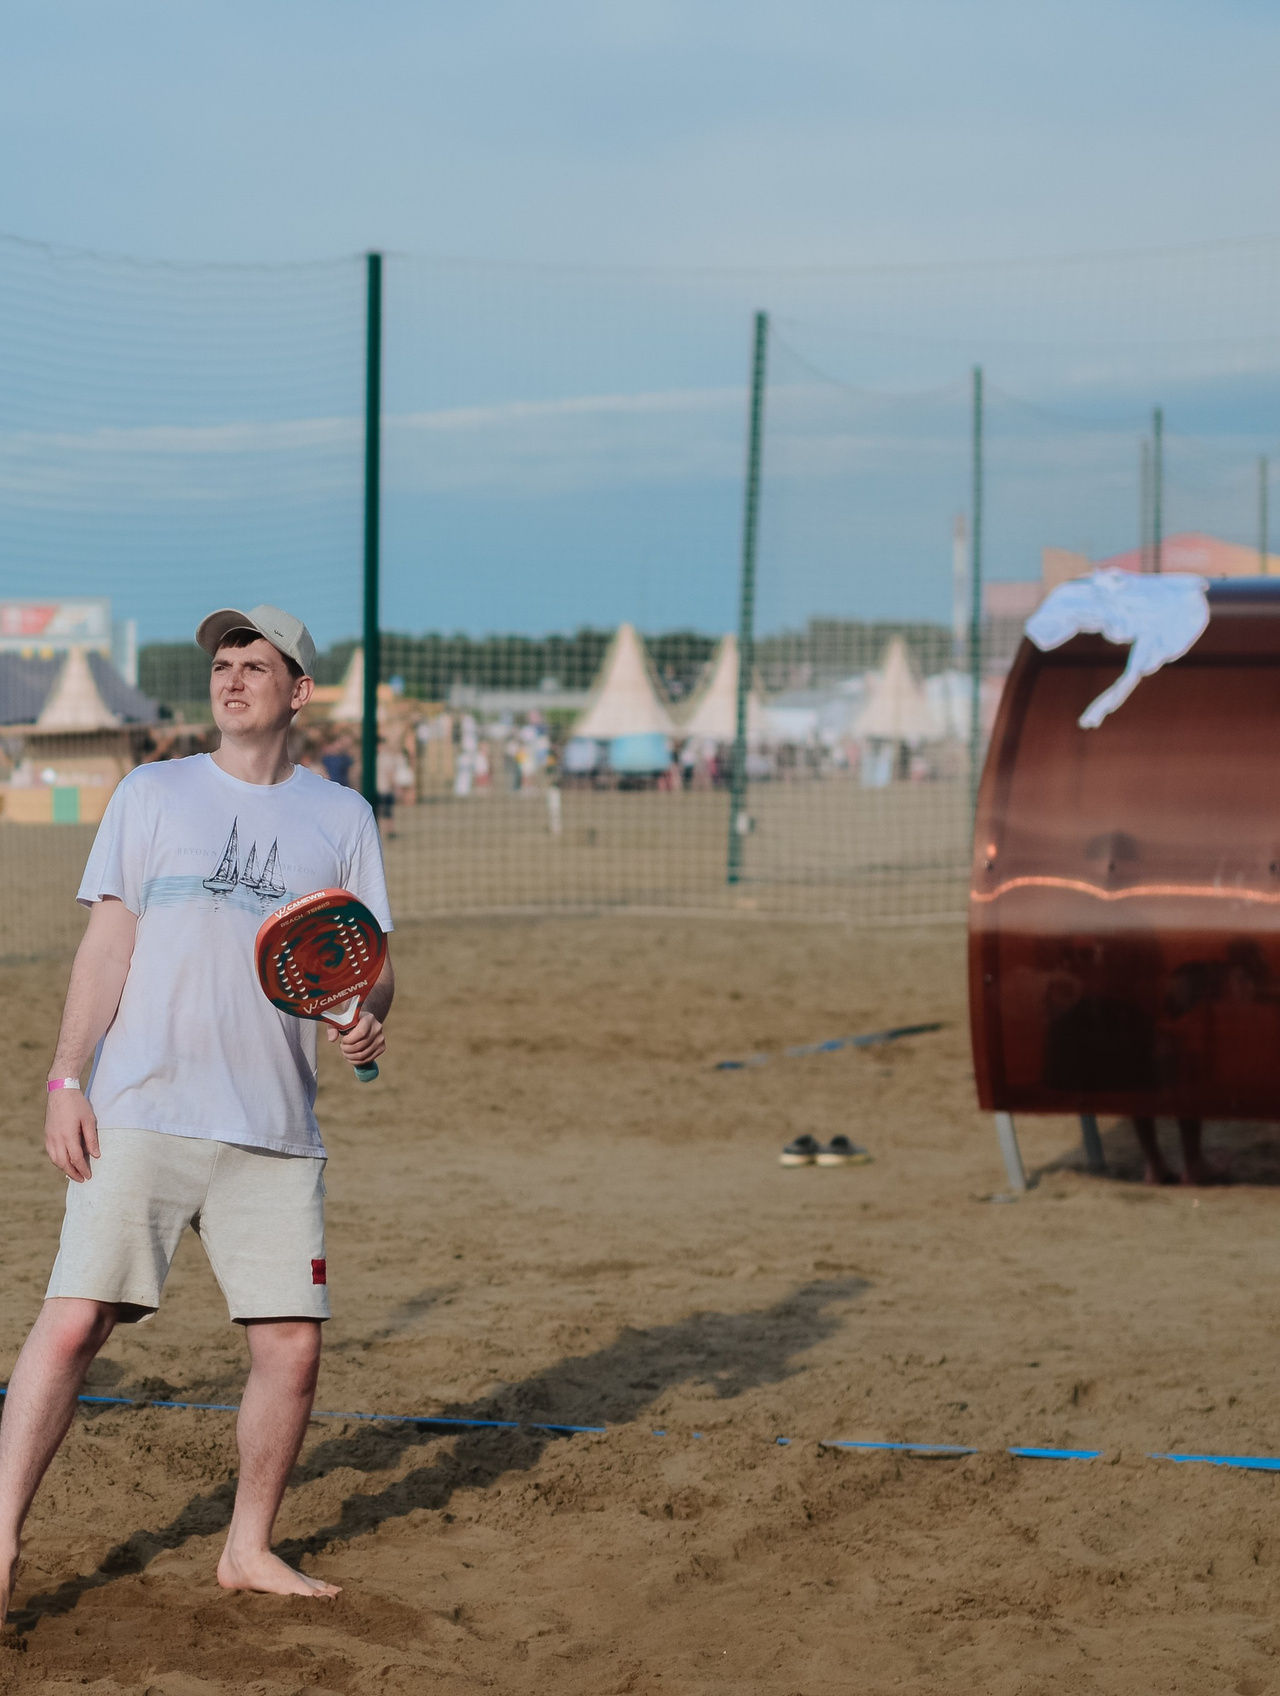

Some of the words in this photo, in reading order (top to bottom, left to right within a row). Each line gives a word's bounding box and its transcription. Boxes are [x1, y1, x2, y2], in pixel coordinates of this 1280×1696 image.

[280, 914, 304, 928] BEACH
[307, 901, 330, 915] TENNIS
[286, 891, 326, 911] CAMEWIN
[320, 979, 368, 1006] CAMEWIN
